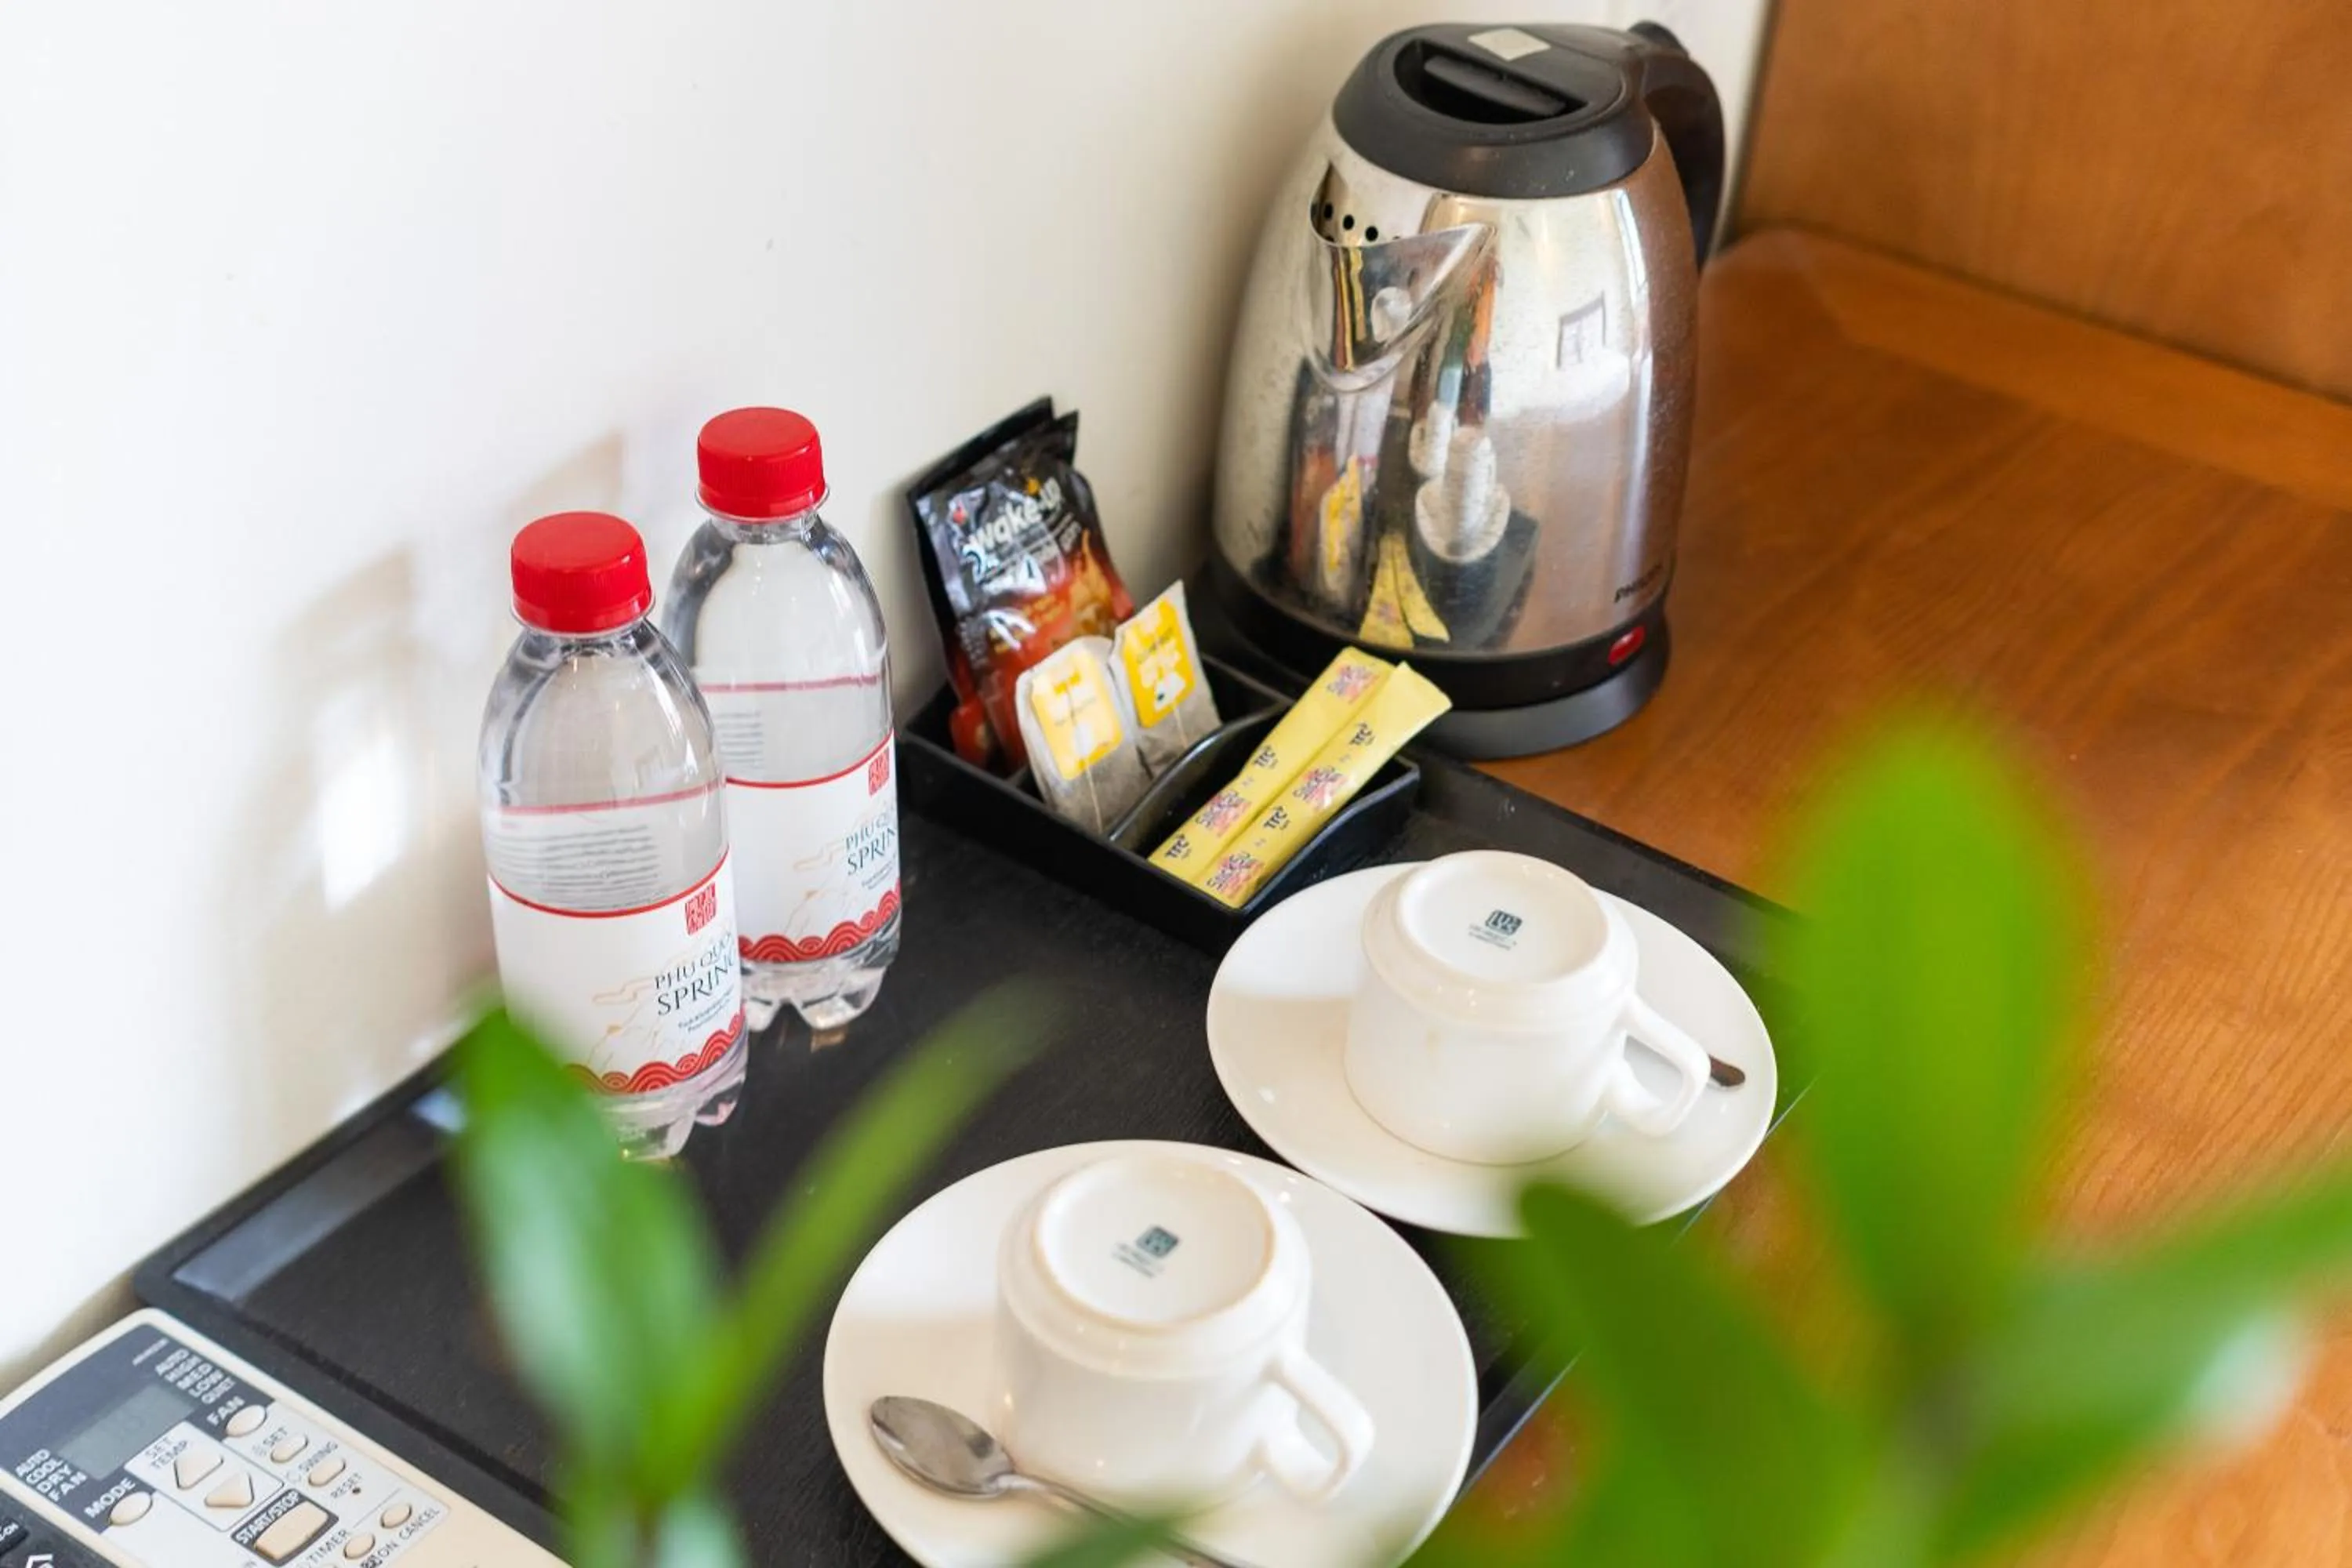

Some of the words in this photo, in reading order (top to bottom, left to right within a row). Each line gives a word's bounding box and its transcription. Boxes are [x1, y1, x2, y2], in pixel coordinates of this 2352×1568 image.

[848, 827, 896, 877] SPRIN
[154, 1348, 190, 1376] AUTO
[176, 1363, 213, 1390] MED
[188, 1369, 224, 1398] LOW
[206, 1396, 245, 1426] FAN
[263, 1426, 289, 1450] SET
[15, 1449, 50, 1478] AUTO
[26, 1457, 64, 1485] COOL
[37, 1464, 72, 1494] DRY
[48, 1471, 88, 1502] FAN
[84, 1477, 136, 1519] MODE
[235, 1489, 303, 1545] START/STOP
[398, 1508, 441, 1541] CANCEL
[307, 1529, 350, 1565] TIMER
